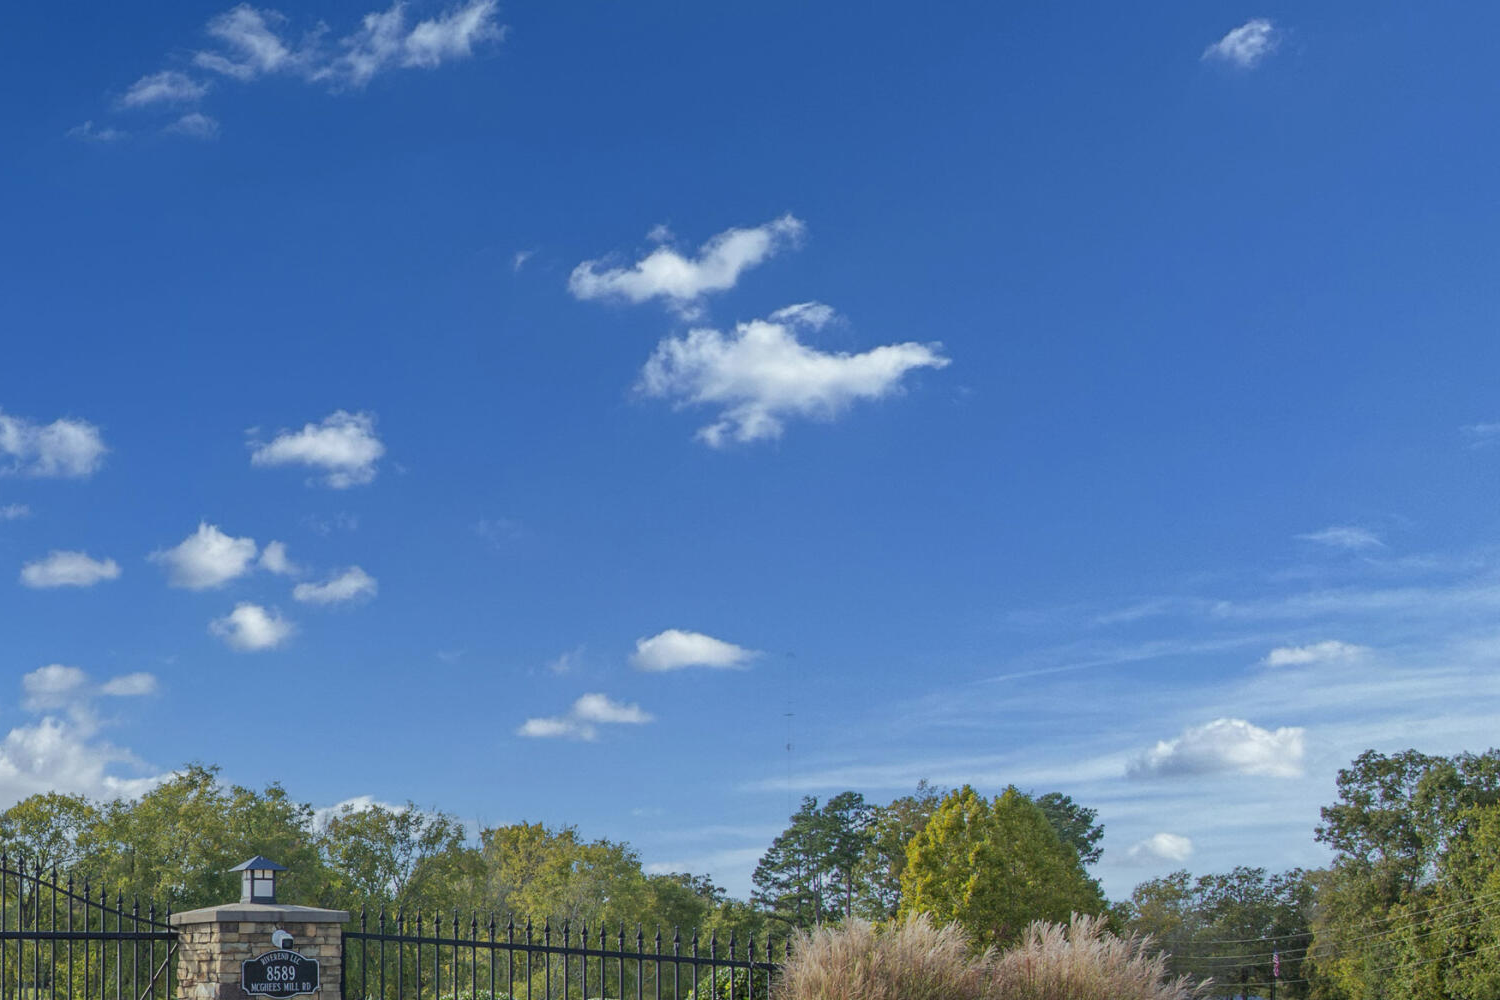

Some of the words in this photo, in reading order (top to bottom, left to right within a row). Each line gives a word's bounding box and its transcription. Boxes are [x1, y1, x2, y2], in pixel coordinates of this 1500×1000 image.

[290, 954, 301, 965] LLC
[267, 966, 296, 981] 8589
[251, 982, 281, 992] MCGHEES
[283, 982, 300, 992] MILL
[302, 981, 311, 991] RD
